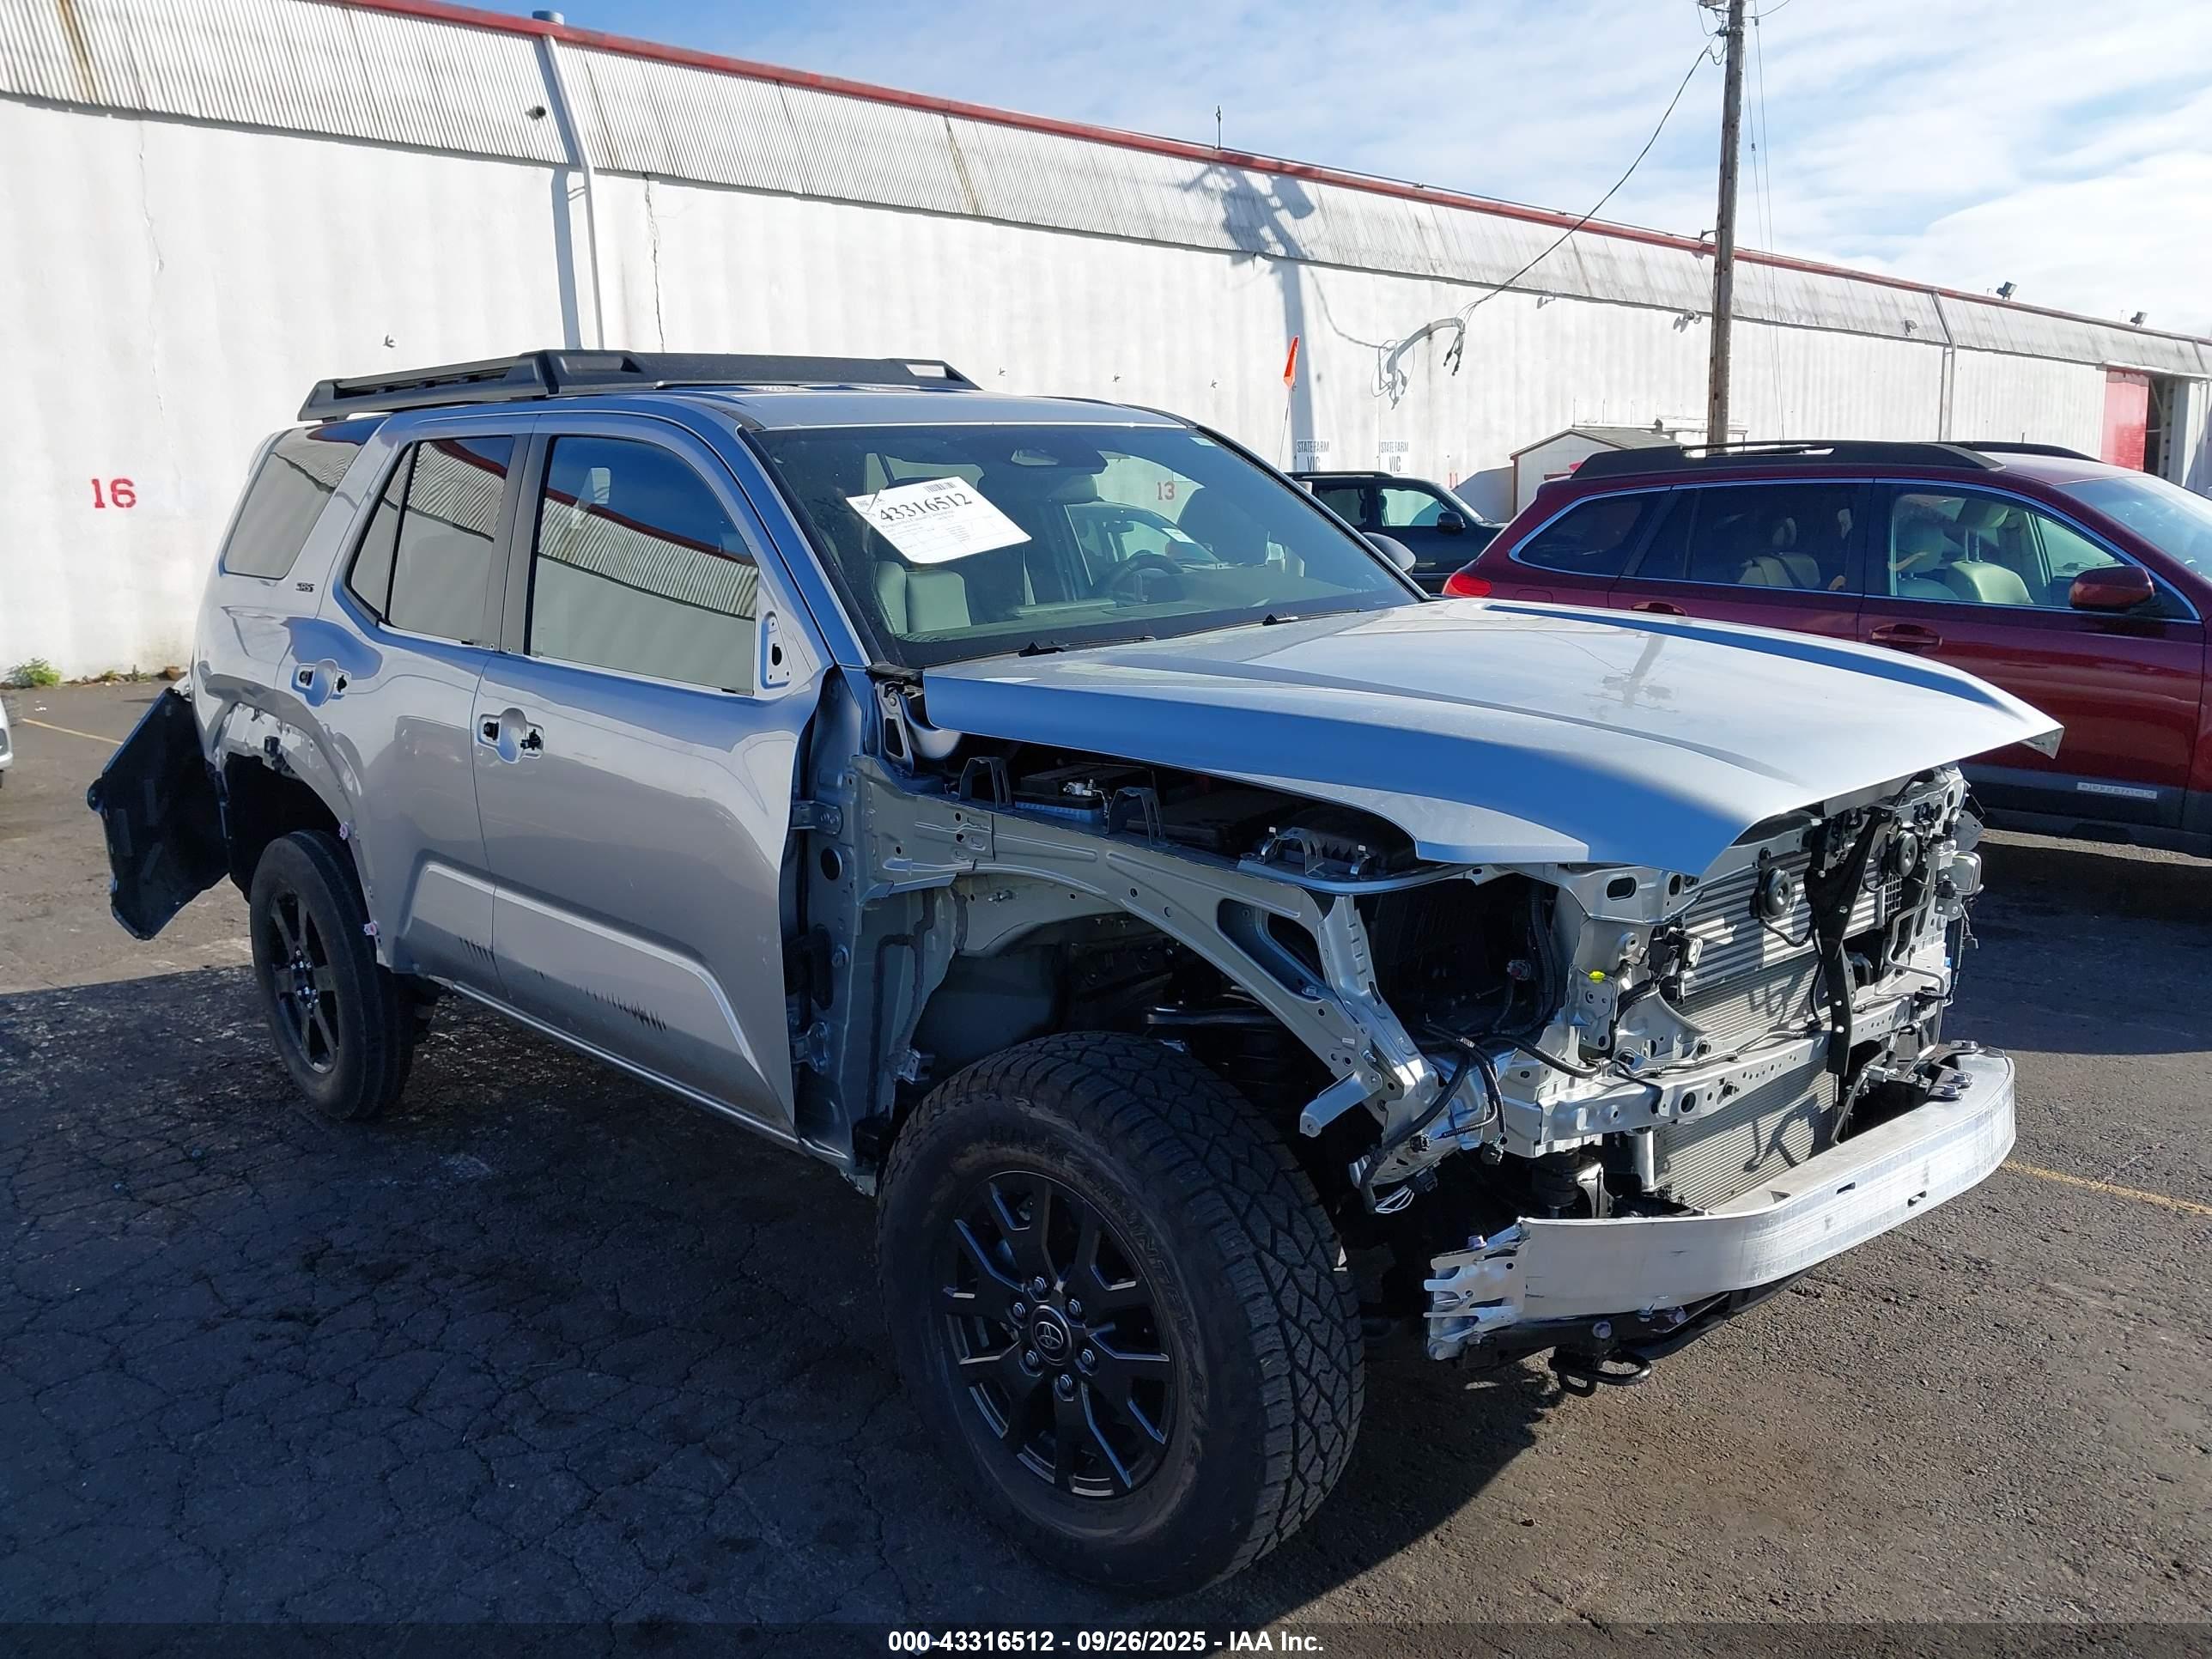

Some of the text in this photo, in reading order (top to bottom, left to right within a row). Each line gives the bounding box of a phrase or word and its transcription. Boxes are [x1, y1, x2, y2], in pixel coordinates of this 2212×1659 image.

[1297, 441, 1329, 453] STATE FARM
[1381, 441, 1409, 453] STATE FARM
[1307, 456, 1321, 472] VIC
[1389, 455, 1401, 472] VIC
[91, 477, 137, 508] 16
[1157, 481, 1176, 501] 13
[880, 493, 973, 521] 43316512
